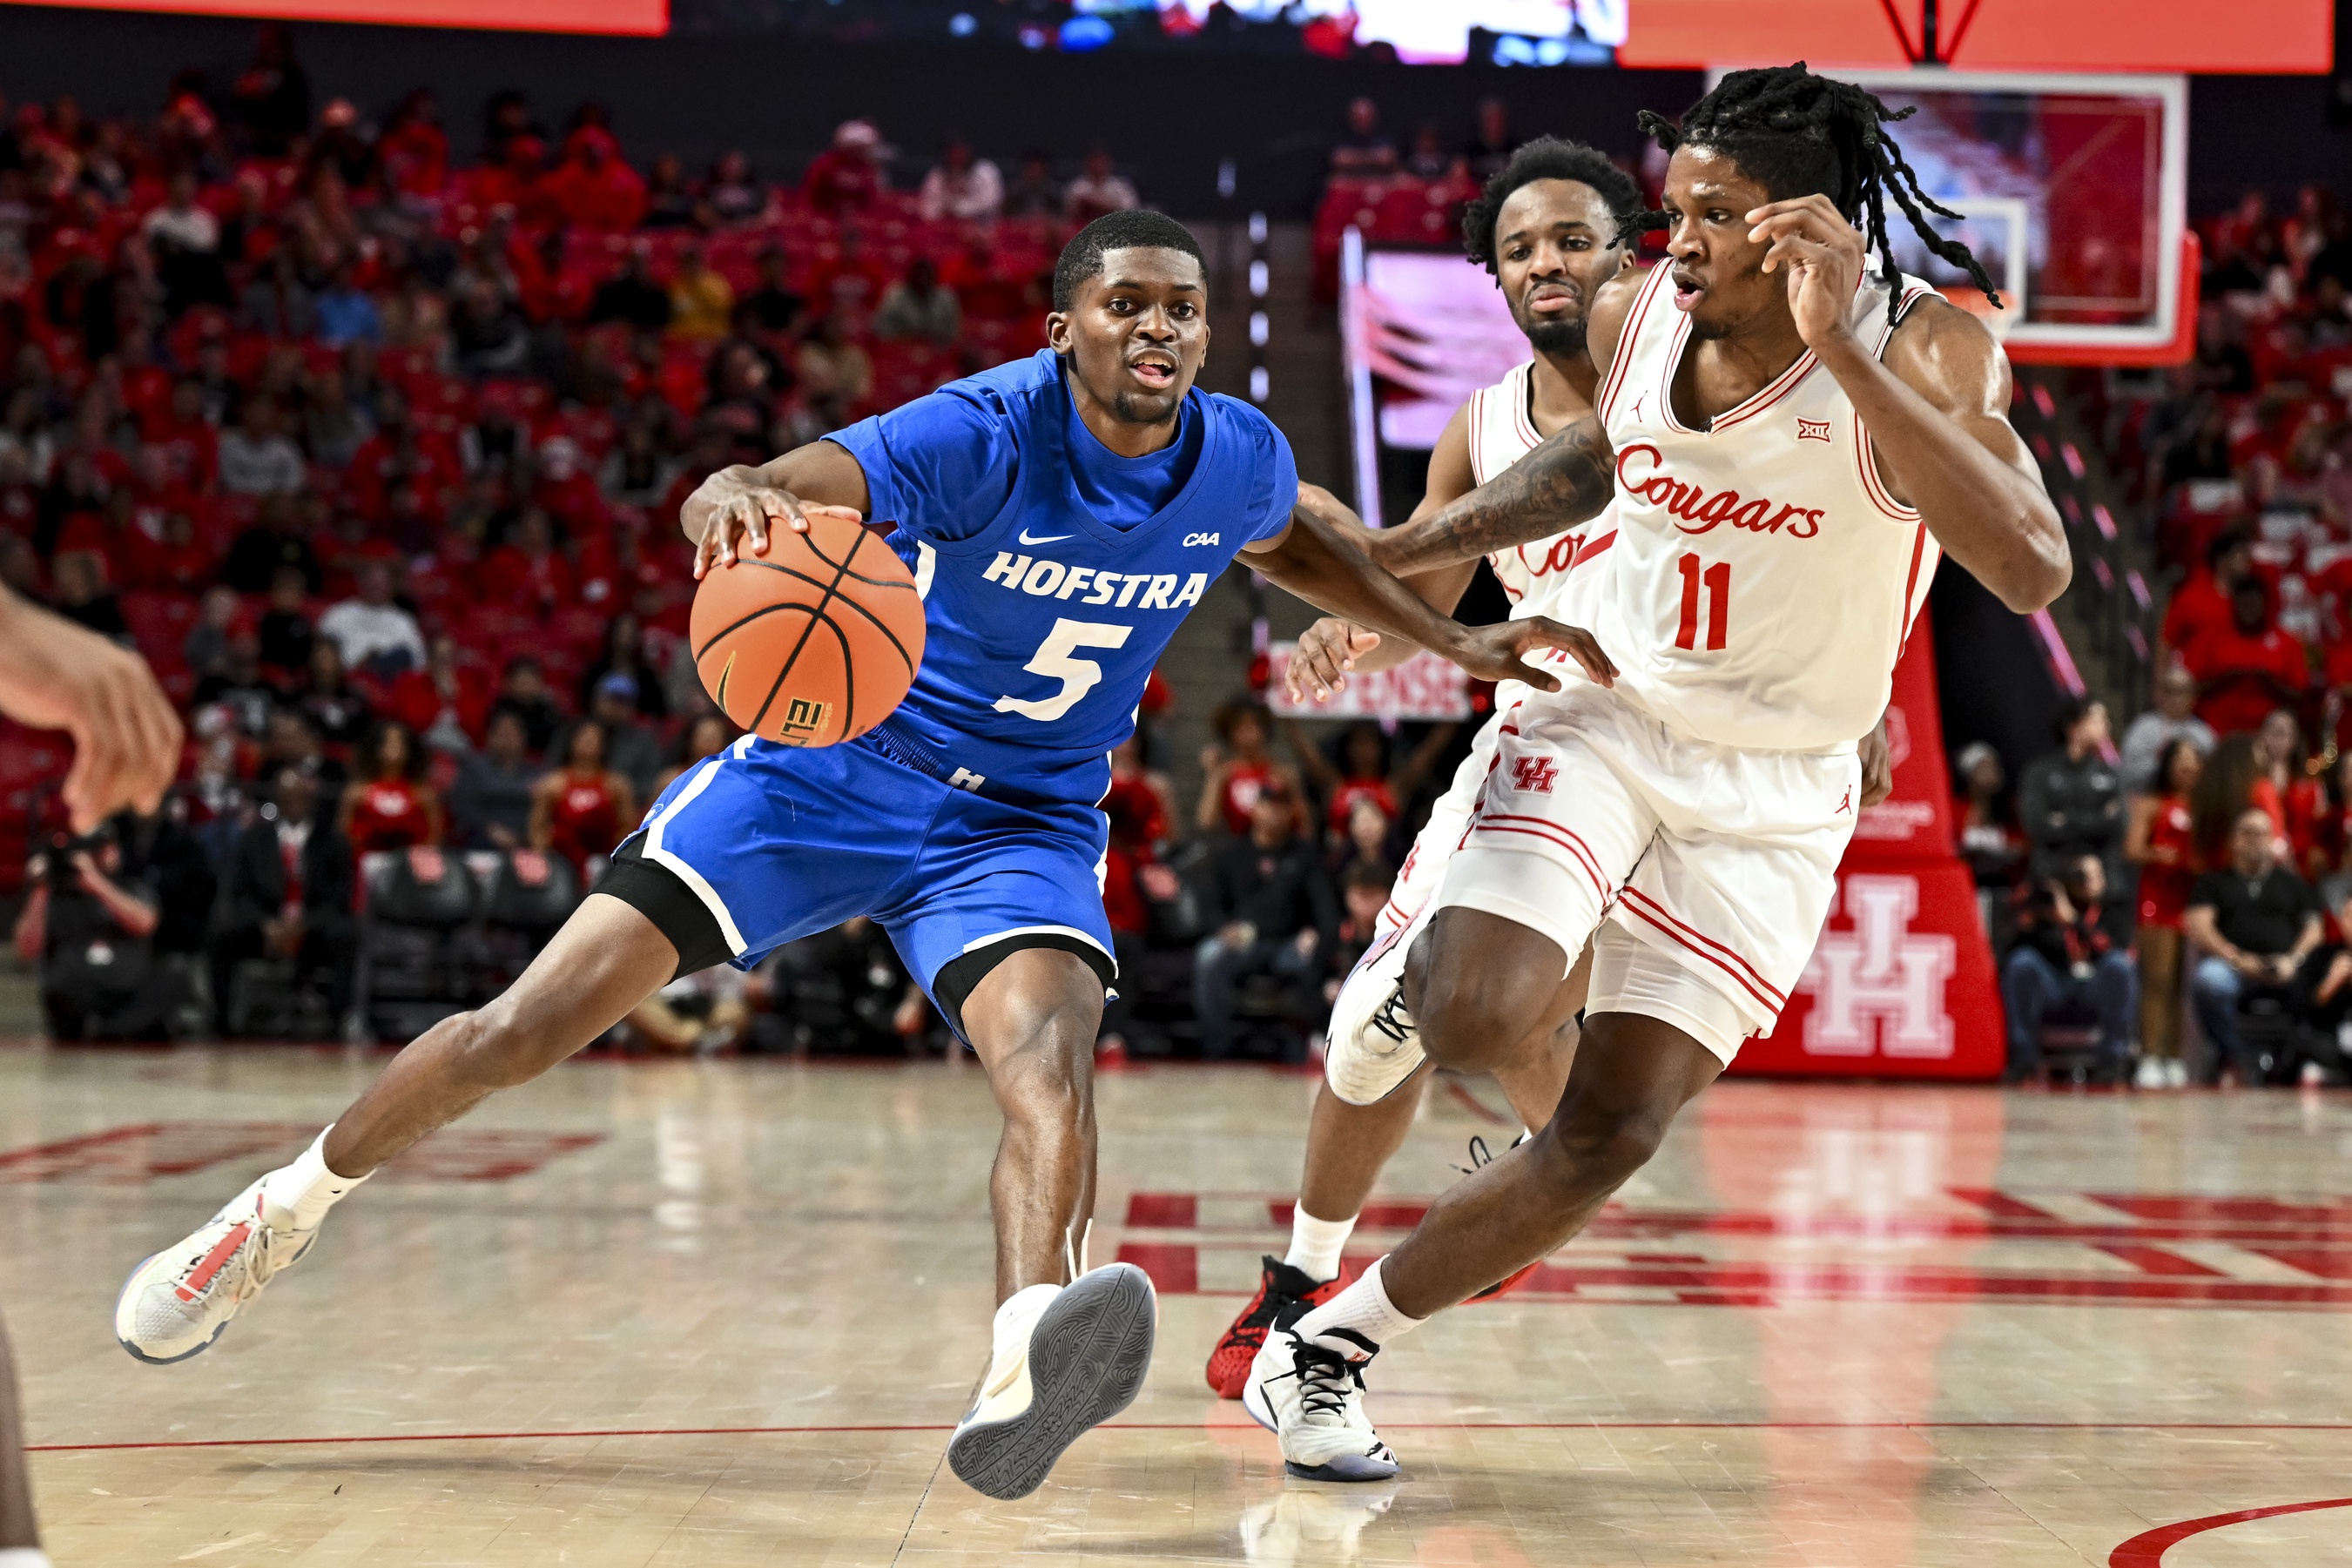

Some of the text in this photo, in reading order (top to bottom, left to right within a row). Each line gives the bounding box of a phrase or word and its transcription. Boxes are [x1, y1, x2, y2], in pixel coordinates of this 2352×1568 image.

[1617, 444, 1825, 539] Cougars
[981, 551, 1209, 609] HOFSTRA
[1183, 532, 1220, 547] CAA
[1675, 553, 1731, 651] 11
[990, 617, 1134, 722] 5
